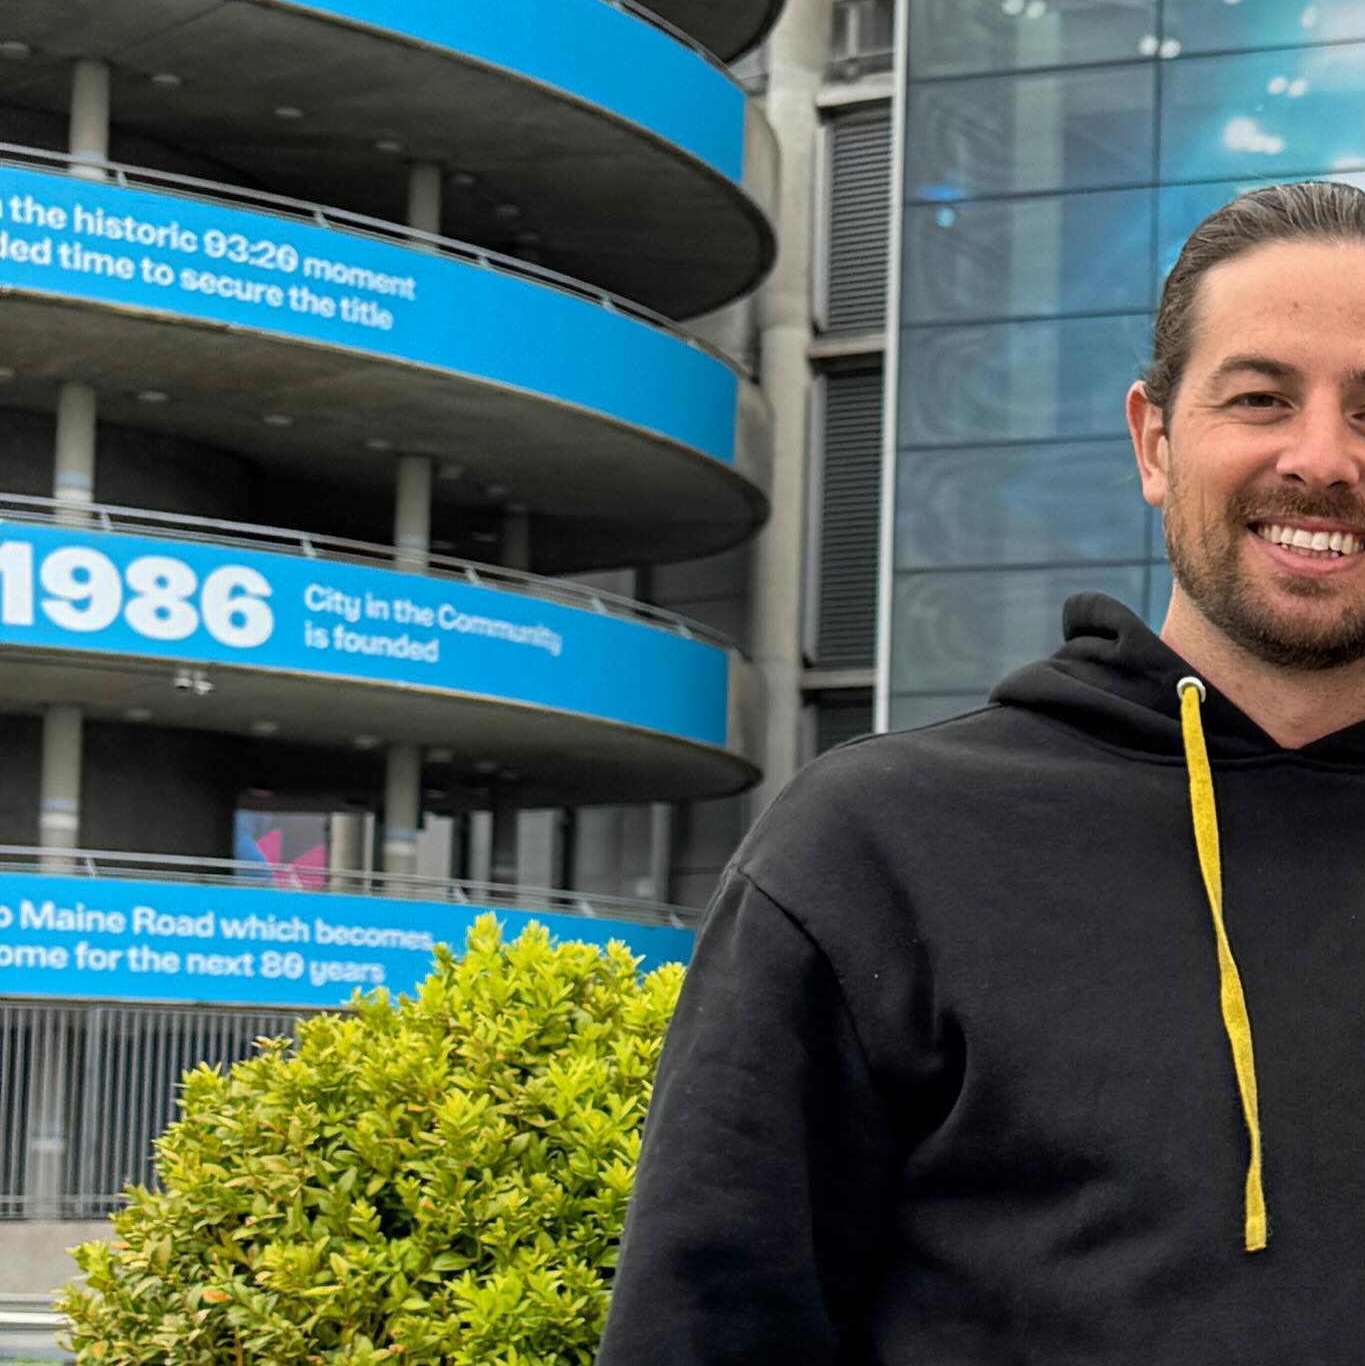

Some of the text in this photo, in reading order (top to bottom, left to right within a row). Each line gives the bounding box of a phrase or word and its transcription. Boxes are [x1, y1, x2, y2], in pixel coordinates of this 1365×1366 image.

[9, 194, 67, 230] the
[72, 203, 198, 254] historic
[203, 228, 299, 274] 93:20
[303, 256, 416, 301] moment
[57, 240, 135, 280] time
[140, 255, 175, 286] to
[179, 267, 284, 308] secure
[288, 284, 336, 318] the
[340, 296, 394, 331] title
[0, 541, 275, 648] 1986
[304, 583, 562, 657] City in the Community
[304, 620, 440, 663] is founded
[20, 899, 126, 935] Maine
[132, 906, 216, 939] Road
[220, 913, 310, 944] which
[314, 918, 434, 951] becomes
[75, 940, 123, 972] for
[127, 943, 181, 975] the
[185, 951, 255, 978] next
[309, 960, 386, 986] years
